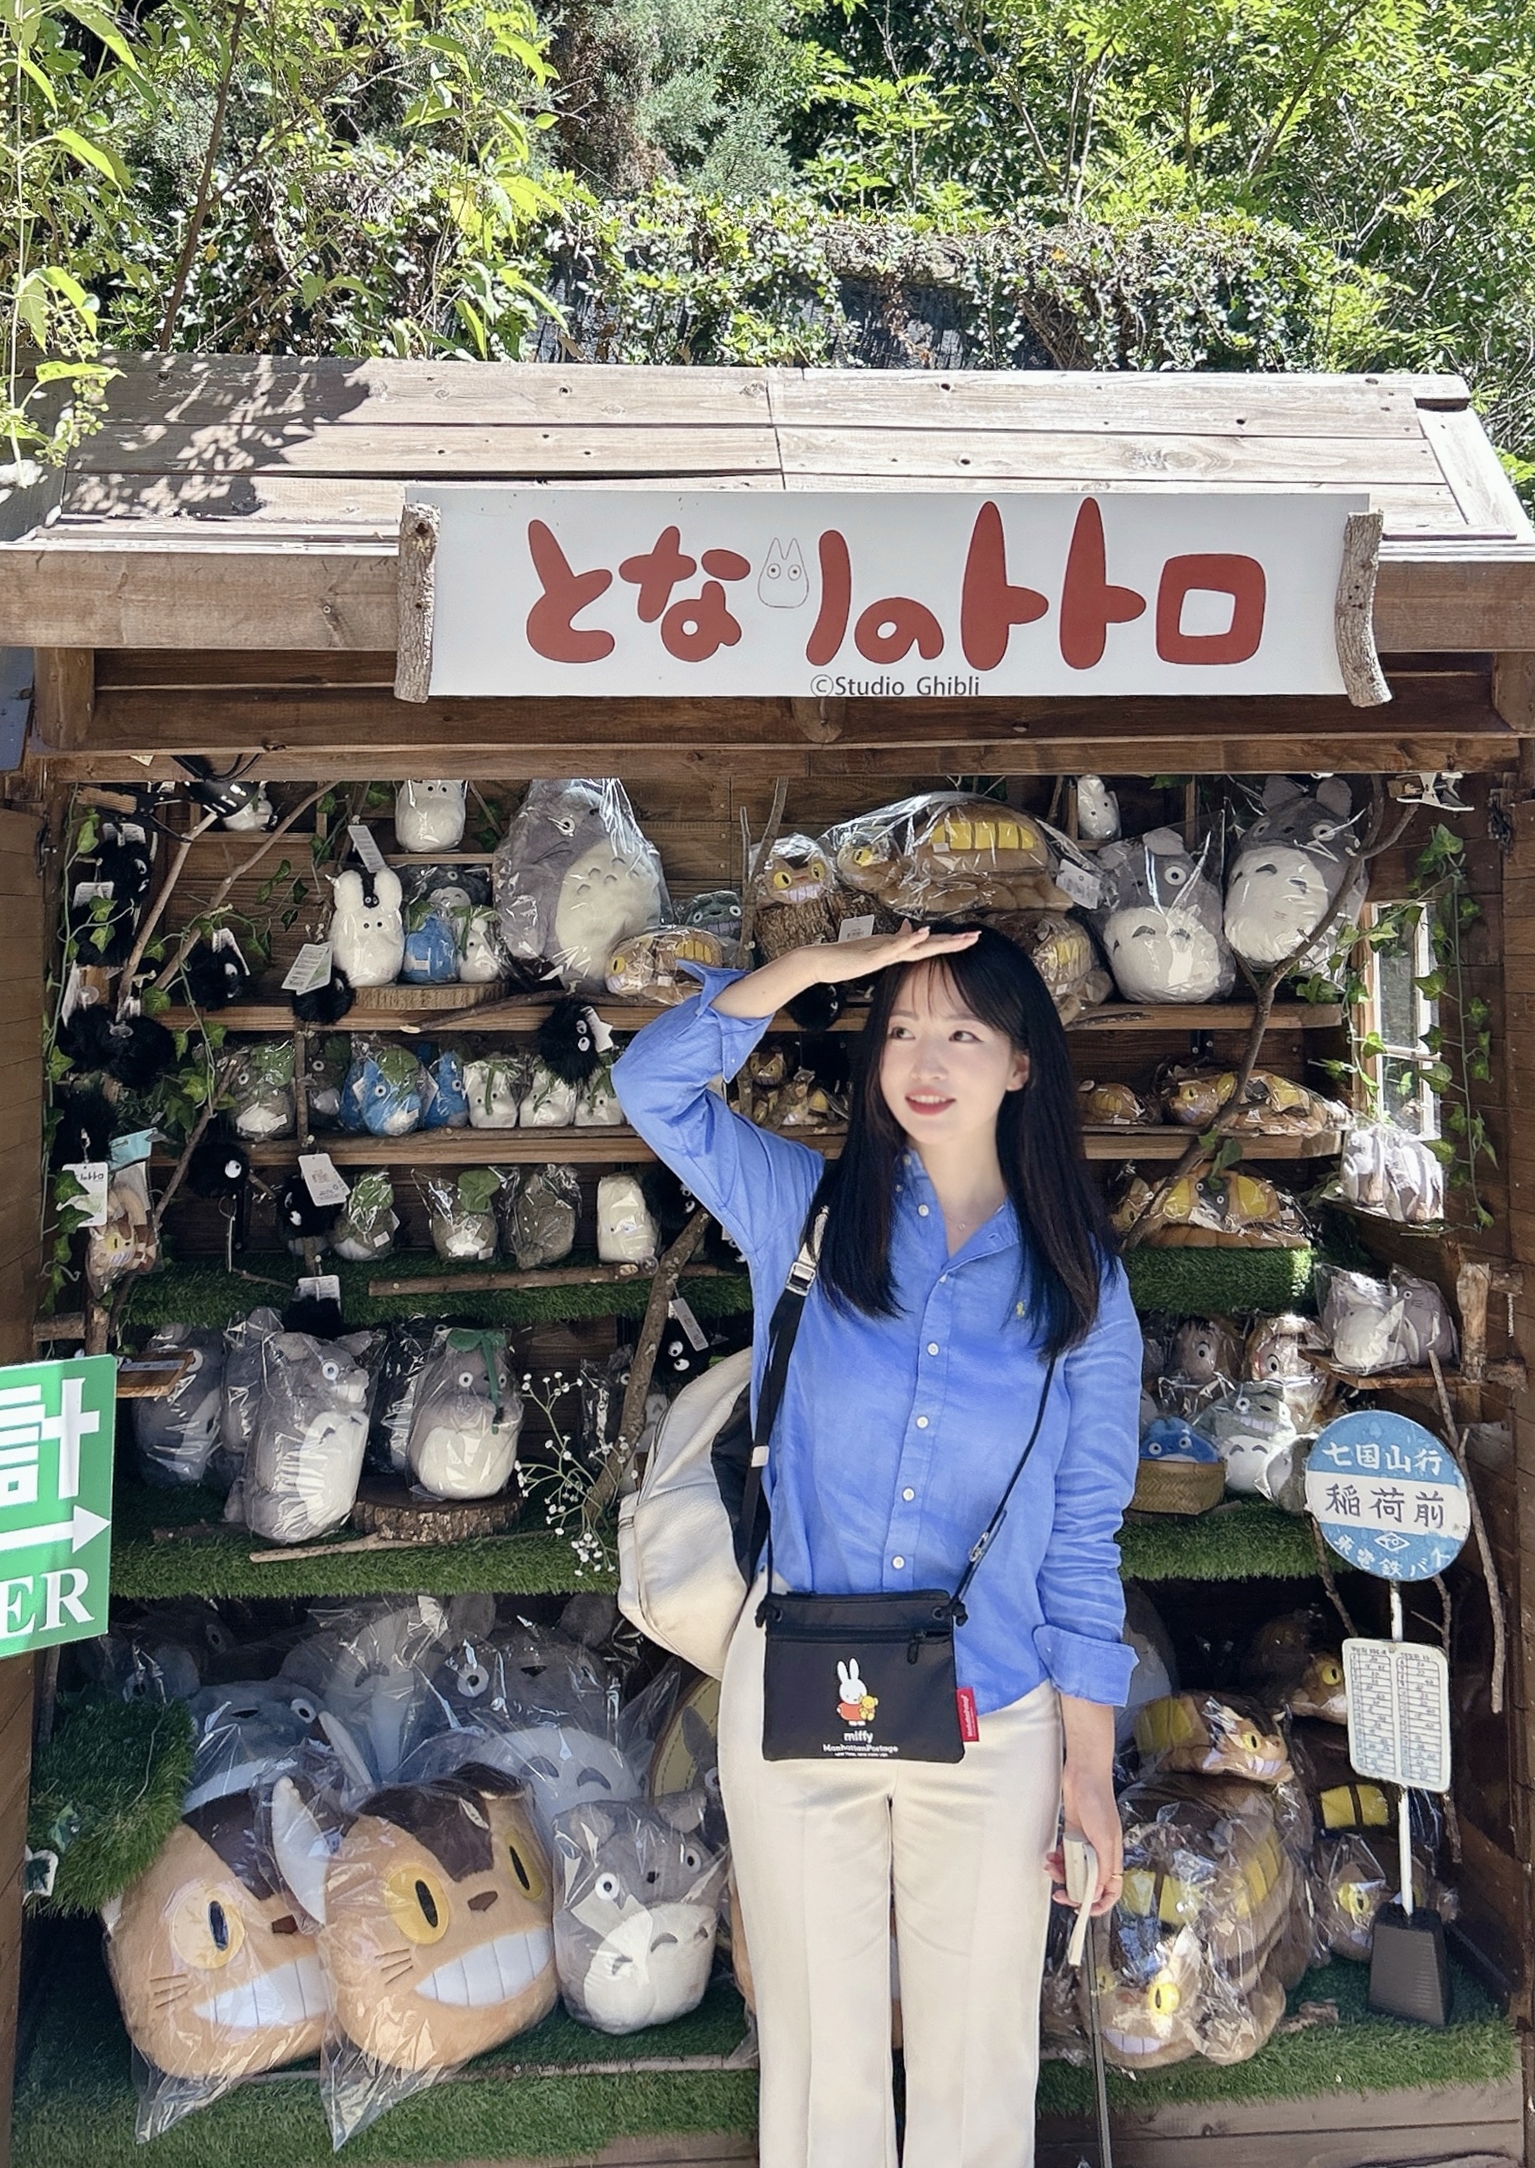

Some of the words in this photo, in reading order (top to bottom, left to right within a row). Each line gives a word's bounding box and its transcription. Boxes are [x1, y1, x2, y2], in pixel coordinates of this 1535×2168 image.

[526, 496, 1266, 671] となりのトトロ
[916, 675, 980, 697] Ghibli
[0, 1376, 101, 1507] 計
[1321, 1441, 1443, 1476] 七国山行
[1324, 1483, 1445, 1529] 稲荷前
[843, 1730, 874, 1744] miffy
